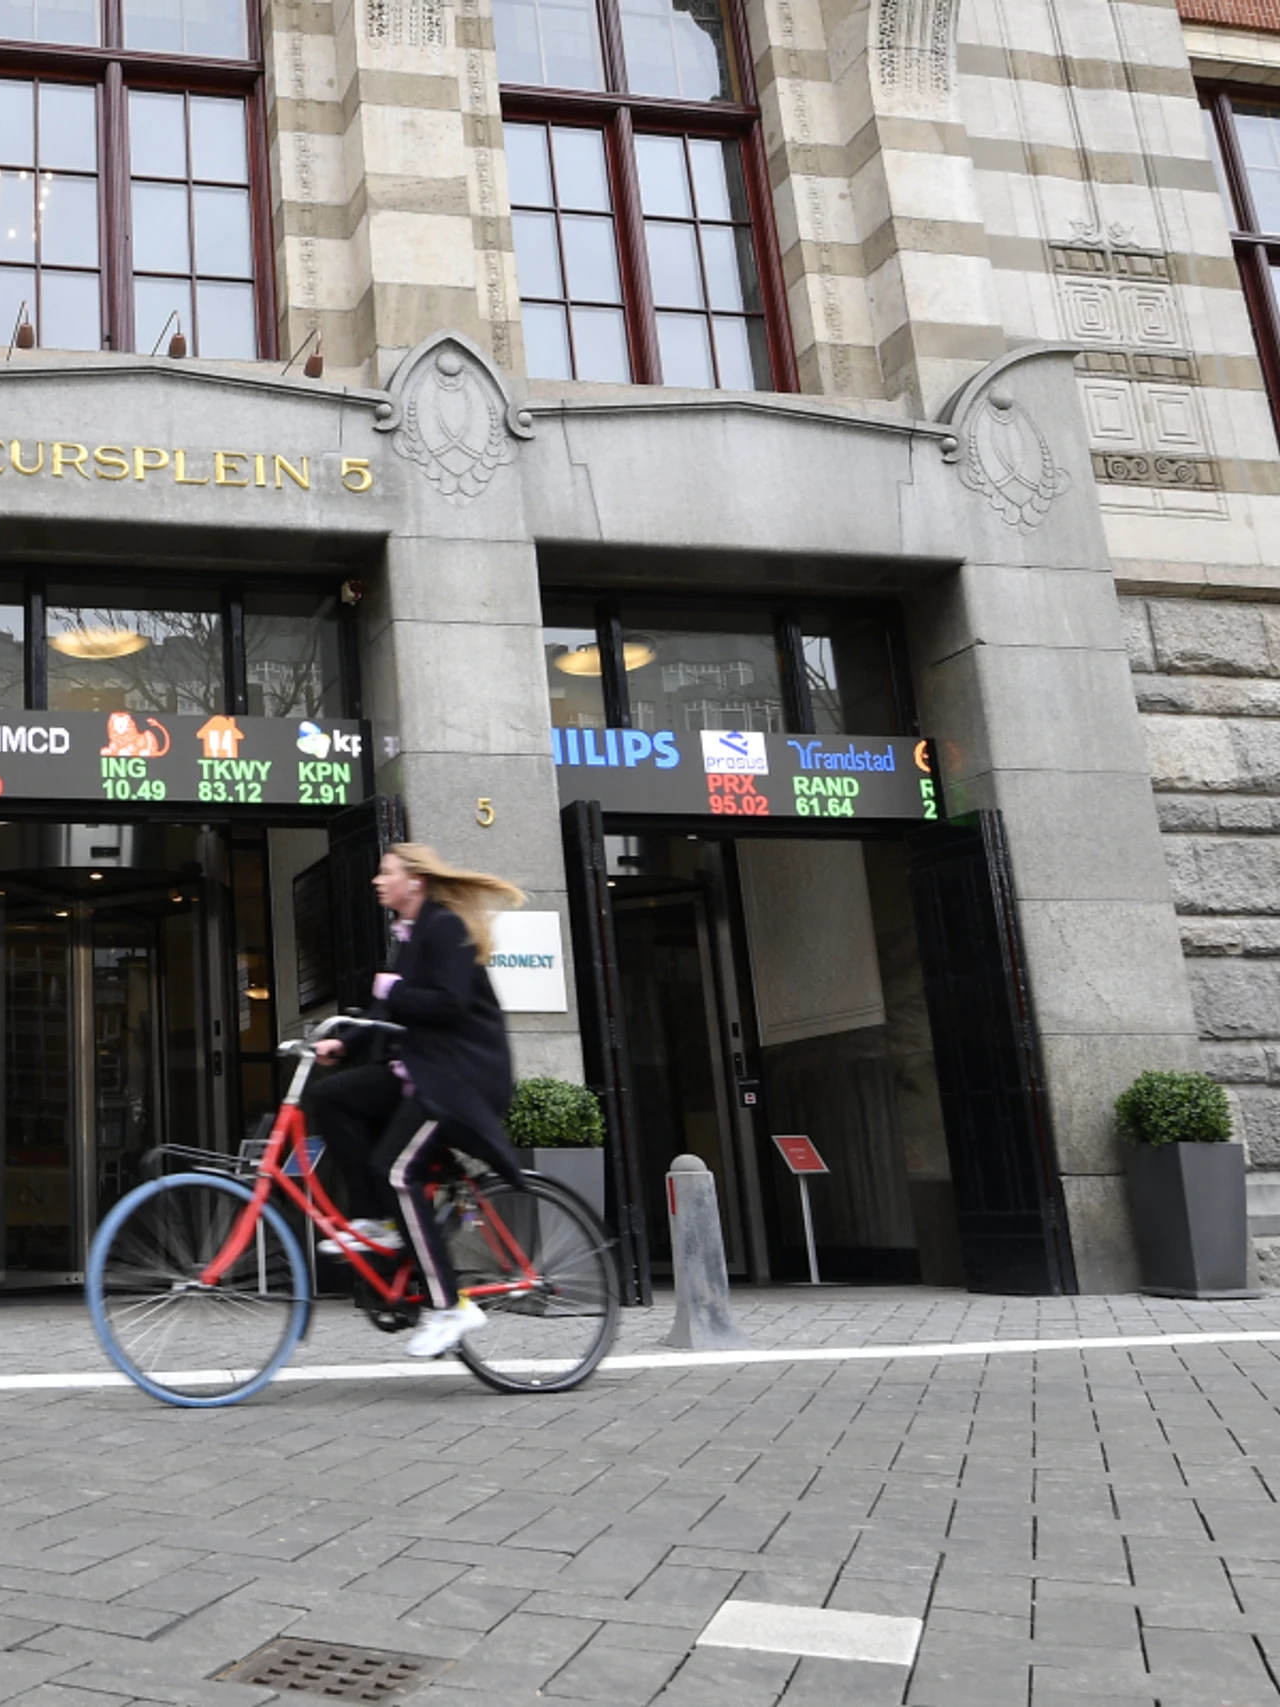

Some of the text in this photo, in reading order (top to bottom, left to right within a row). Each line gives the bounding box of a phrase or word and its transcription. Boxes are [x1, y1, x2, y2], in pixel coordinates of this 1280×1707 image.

[341, 457, 374, 493] 5
[101, 757, 147, 778] ING
[814, 743, 896, 772] randstad
[197, 759, 272, 781] TKWY
[299, 761, 351, 783] KPN
[102, 779, 167, 801] 10.49
[198, 781, 263, 803] 83.12
[299, 783, 347, 804] 2.91
[707, 774, 757, 794] PRX
[792, 776, 859, 797] RAND
[477, 797, 495, 827] 5
[708, 795, 769, 815] 95.02
[795, 797, 854, 817] 61.64
[488, 953, 553, 969] URONEXT
